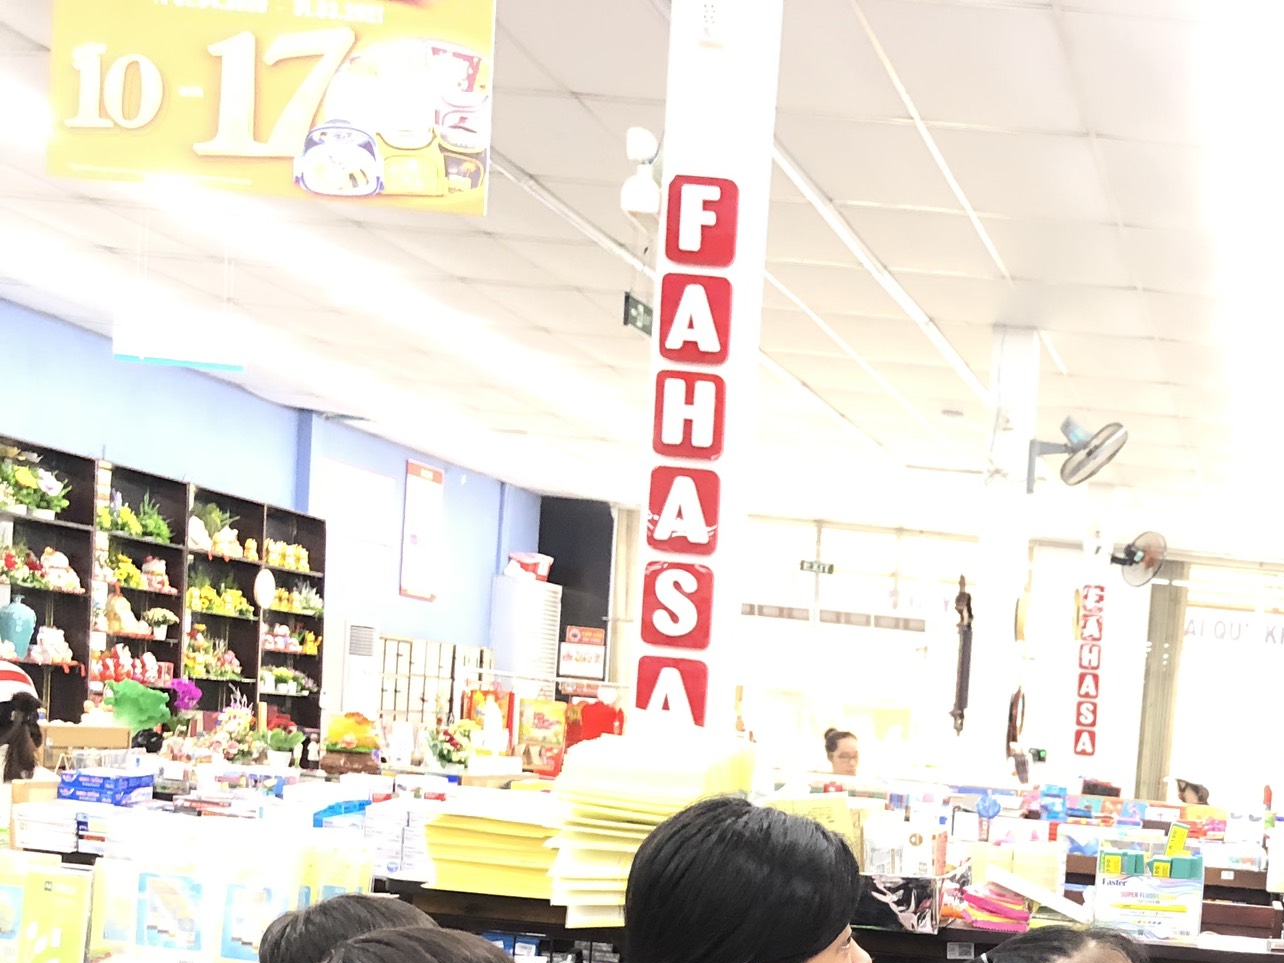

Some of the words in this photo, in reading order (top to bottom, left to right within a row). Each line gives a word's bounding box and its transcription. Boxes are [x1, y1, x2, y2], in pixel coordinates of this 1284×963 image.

[64, 43, 164, 129] 10
[192, 27, 356, 158] 17
[644, 183, 723, 728] FAHASA
[1075, 585, 1104, 753] FAHASA
